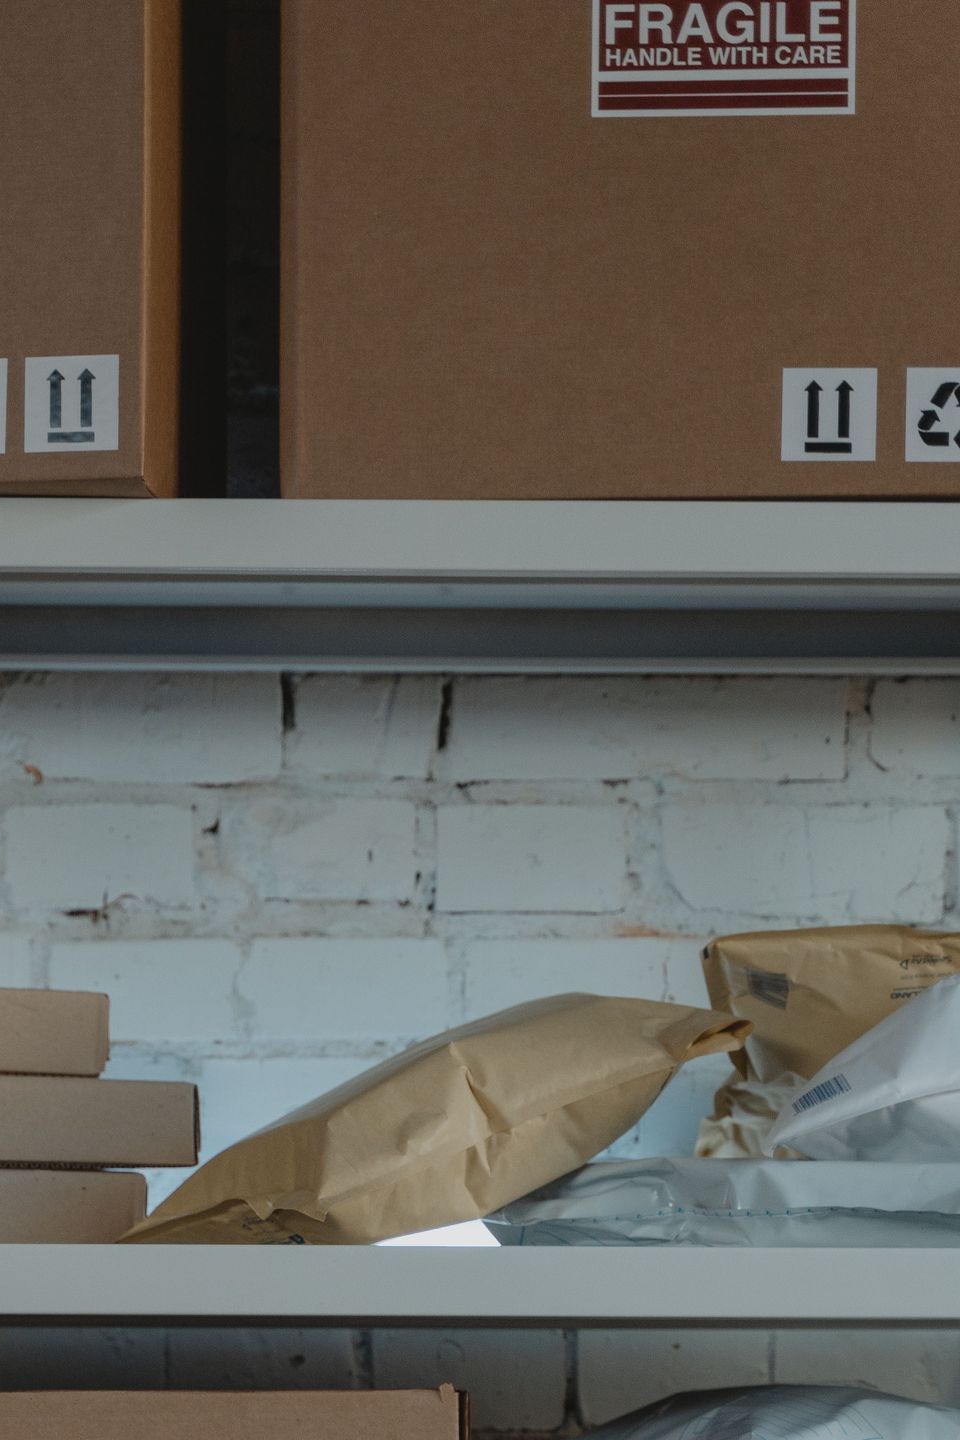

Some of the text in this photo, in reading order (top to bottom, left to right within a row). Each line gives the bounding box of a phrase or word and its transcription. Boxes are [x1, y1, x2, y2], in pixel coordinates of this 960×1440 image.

[604, 1, 842, 46] FRAGILE
[605, 44, 842, 67] HANDLE WITH CARE
